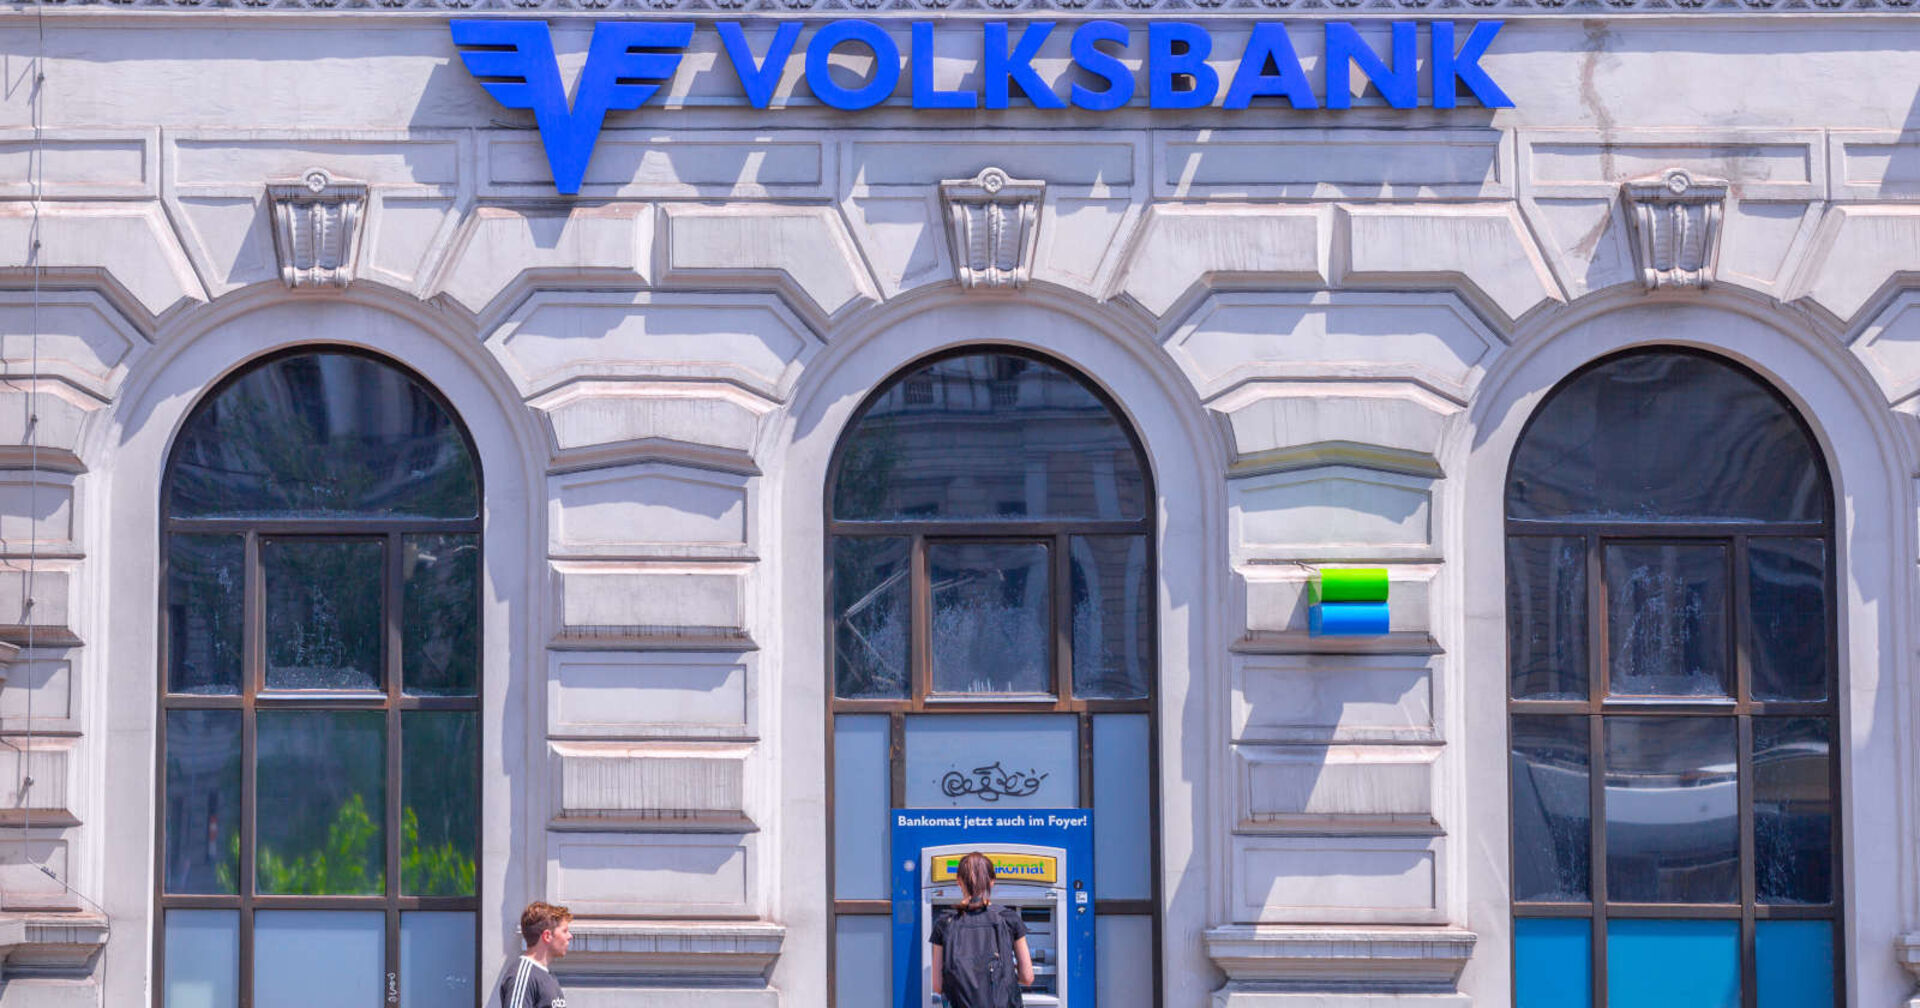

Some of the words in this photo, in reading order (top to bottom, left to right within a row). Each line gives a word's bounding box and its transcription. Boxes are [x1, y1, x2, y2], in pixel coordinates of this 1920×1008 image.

[714, 20, 1515, 111] VOLKSBANK
[897, 815, 961, 827] Bankomat
[963, 815, 993, 829] jetzt
[996, 815, 1025, 827] auch
[1028, 815, 1045, 827] im
[1048, 815, 1087, 830] Foyer!
